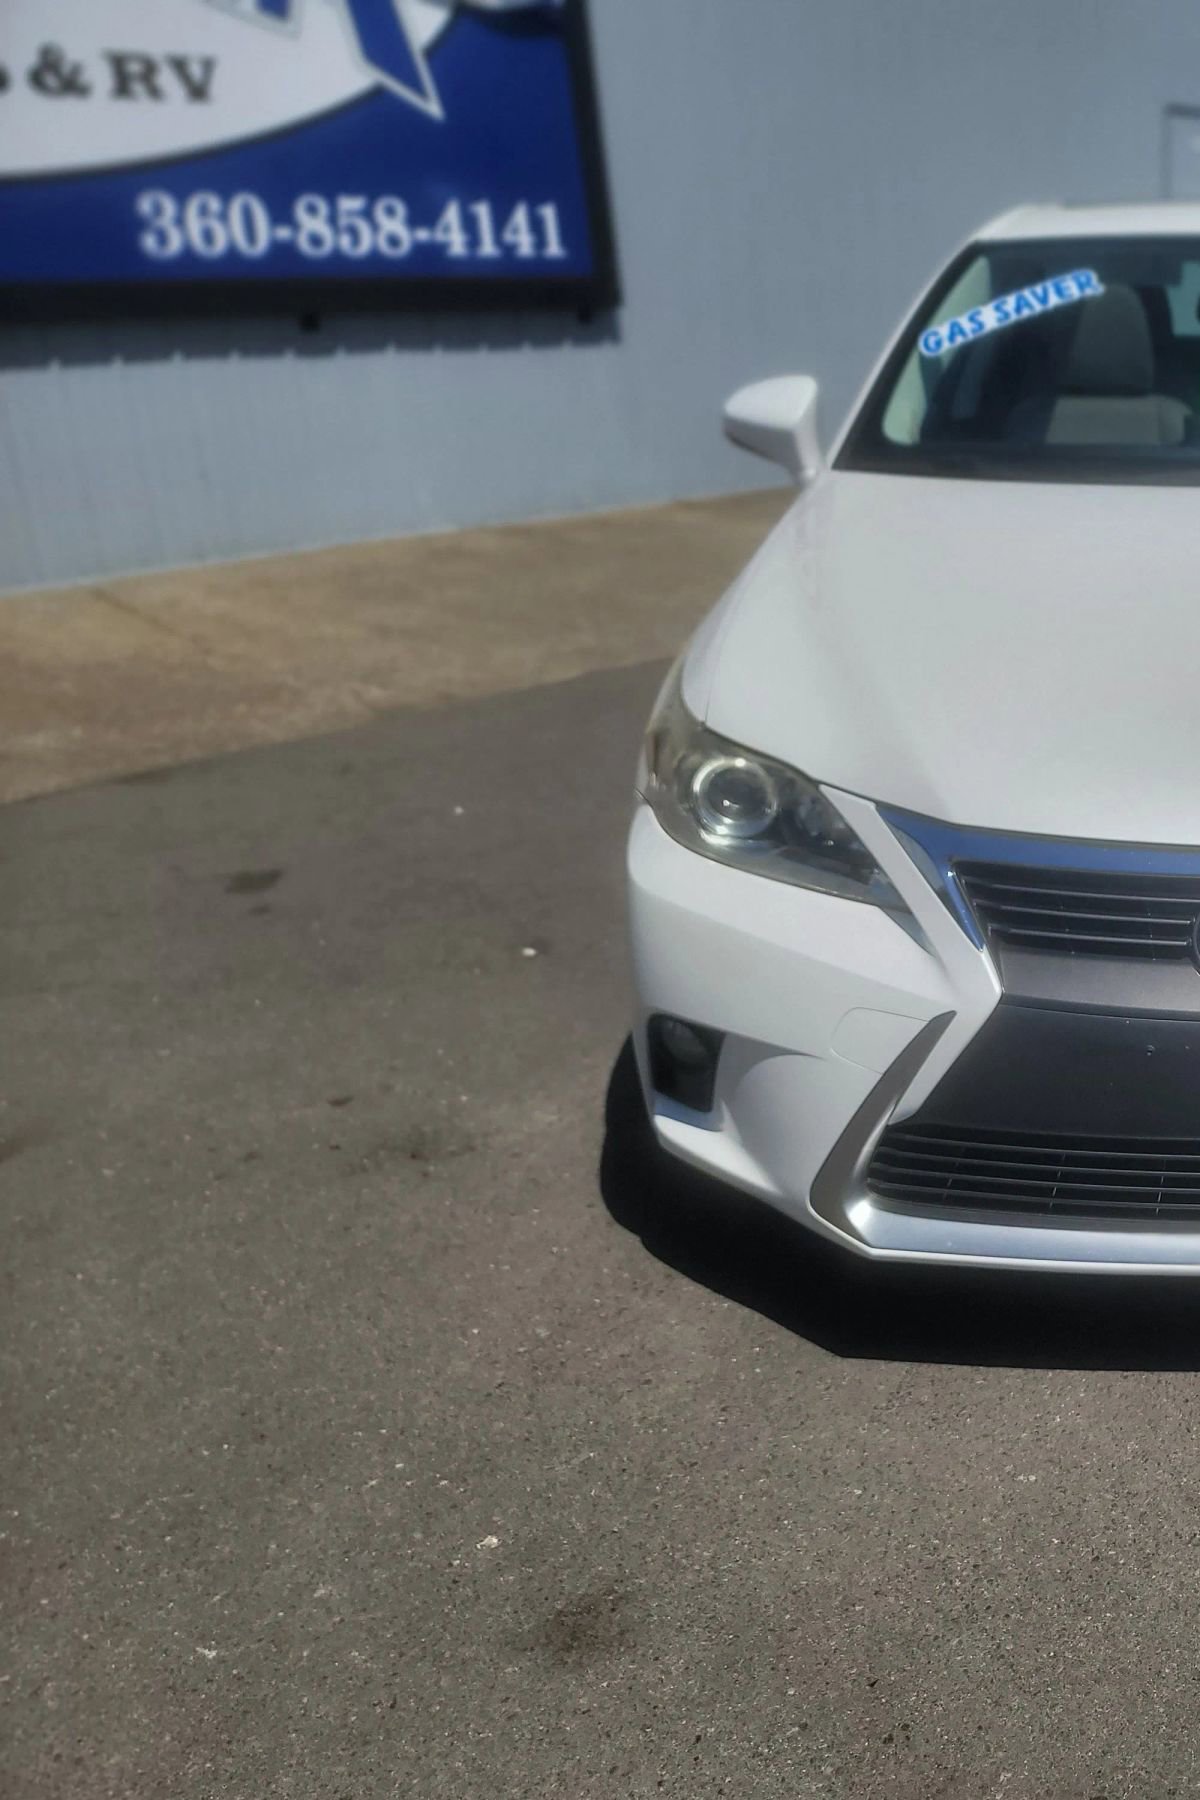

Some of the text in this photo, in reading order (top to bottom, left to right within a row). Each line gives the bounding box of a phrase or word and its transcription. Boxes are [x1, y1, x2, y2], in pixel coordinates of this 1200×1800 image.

[102, 49, 216, 102] RV
[136, 190, 567, 259] 360-858-4141
[921, 270, 1101, 353] GAS SAVER
